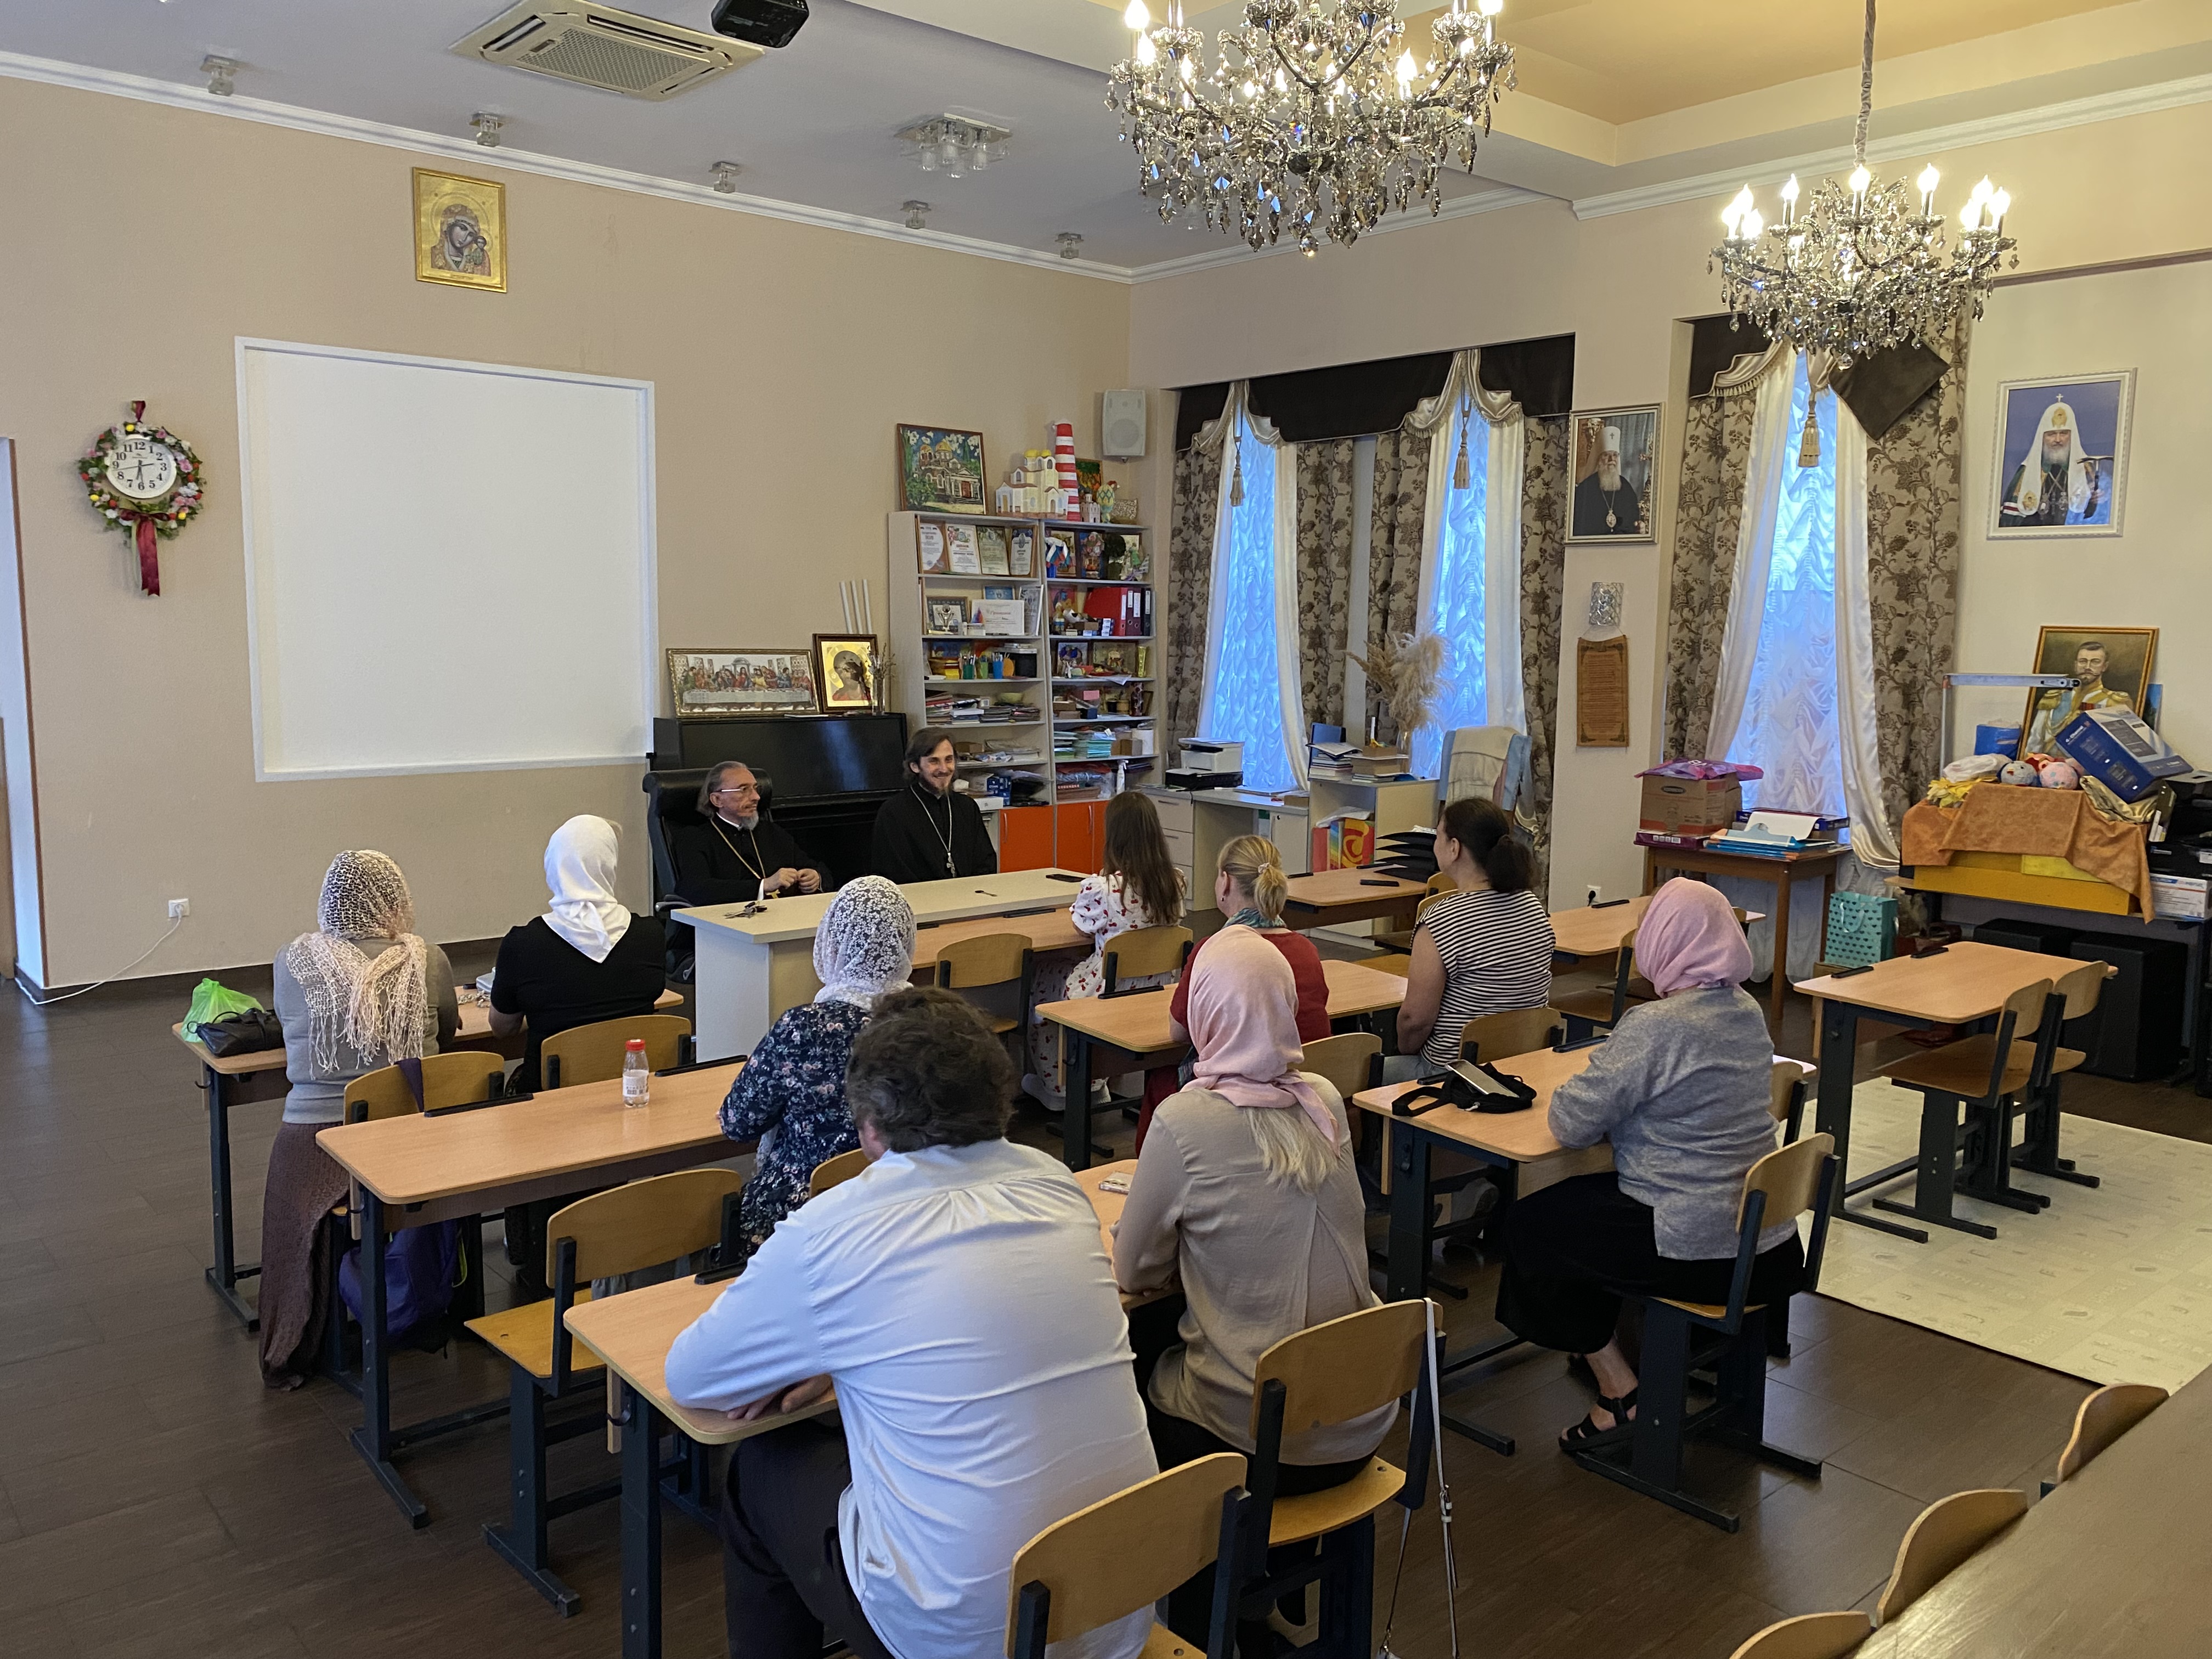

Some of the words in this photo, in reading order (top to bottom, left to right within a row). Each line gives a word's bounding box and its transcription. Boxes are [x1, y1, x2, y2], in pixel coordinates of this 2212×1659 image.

[134, 442, 145, 450] 12
[149, 445, 154, 454] 1
[116, 452, 126, 460] 10
[156, 452, 163, 460] 2
[160, 462, 167, 471] 3
[117, 471, 124, 479] 8
[156, 473, 162, 481] 4
[127, 479, 133, 488] 7
[138, 482, 144, 490] 6
[149, 480, 155, 488] 5
